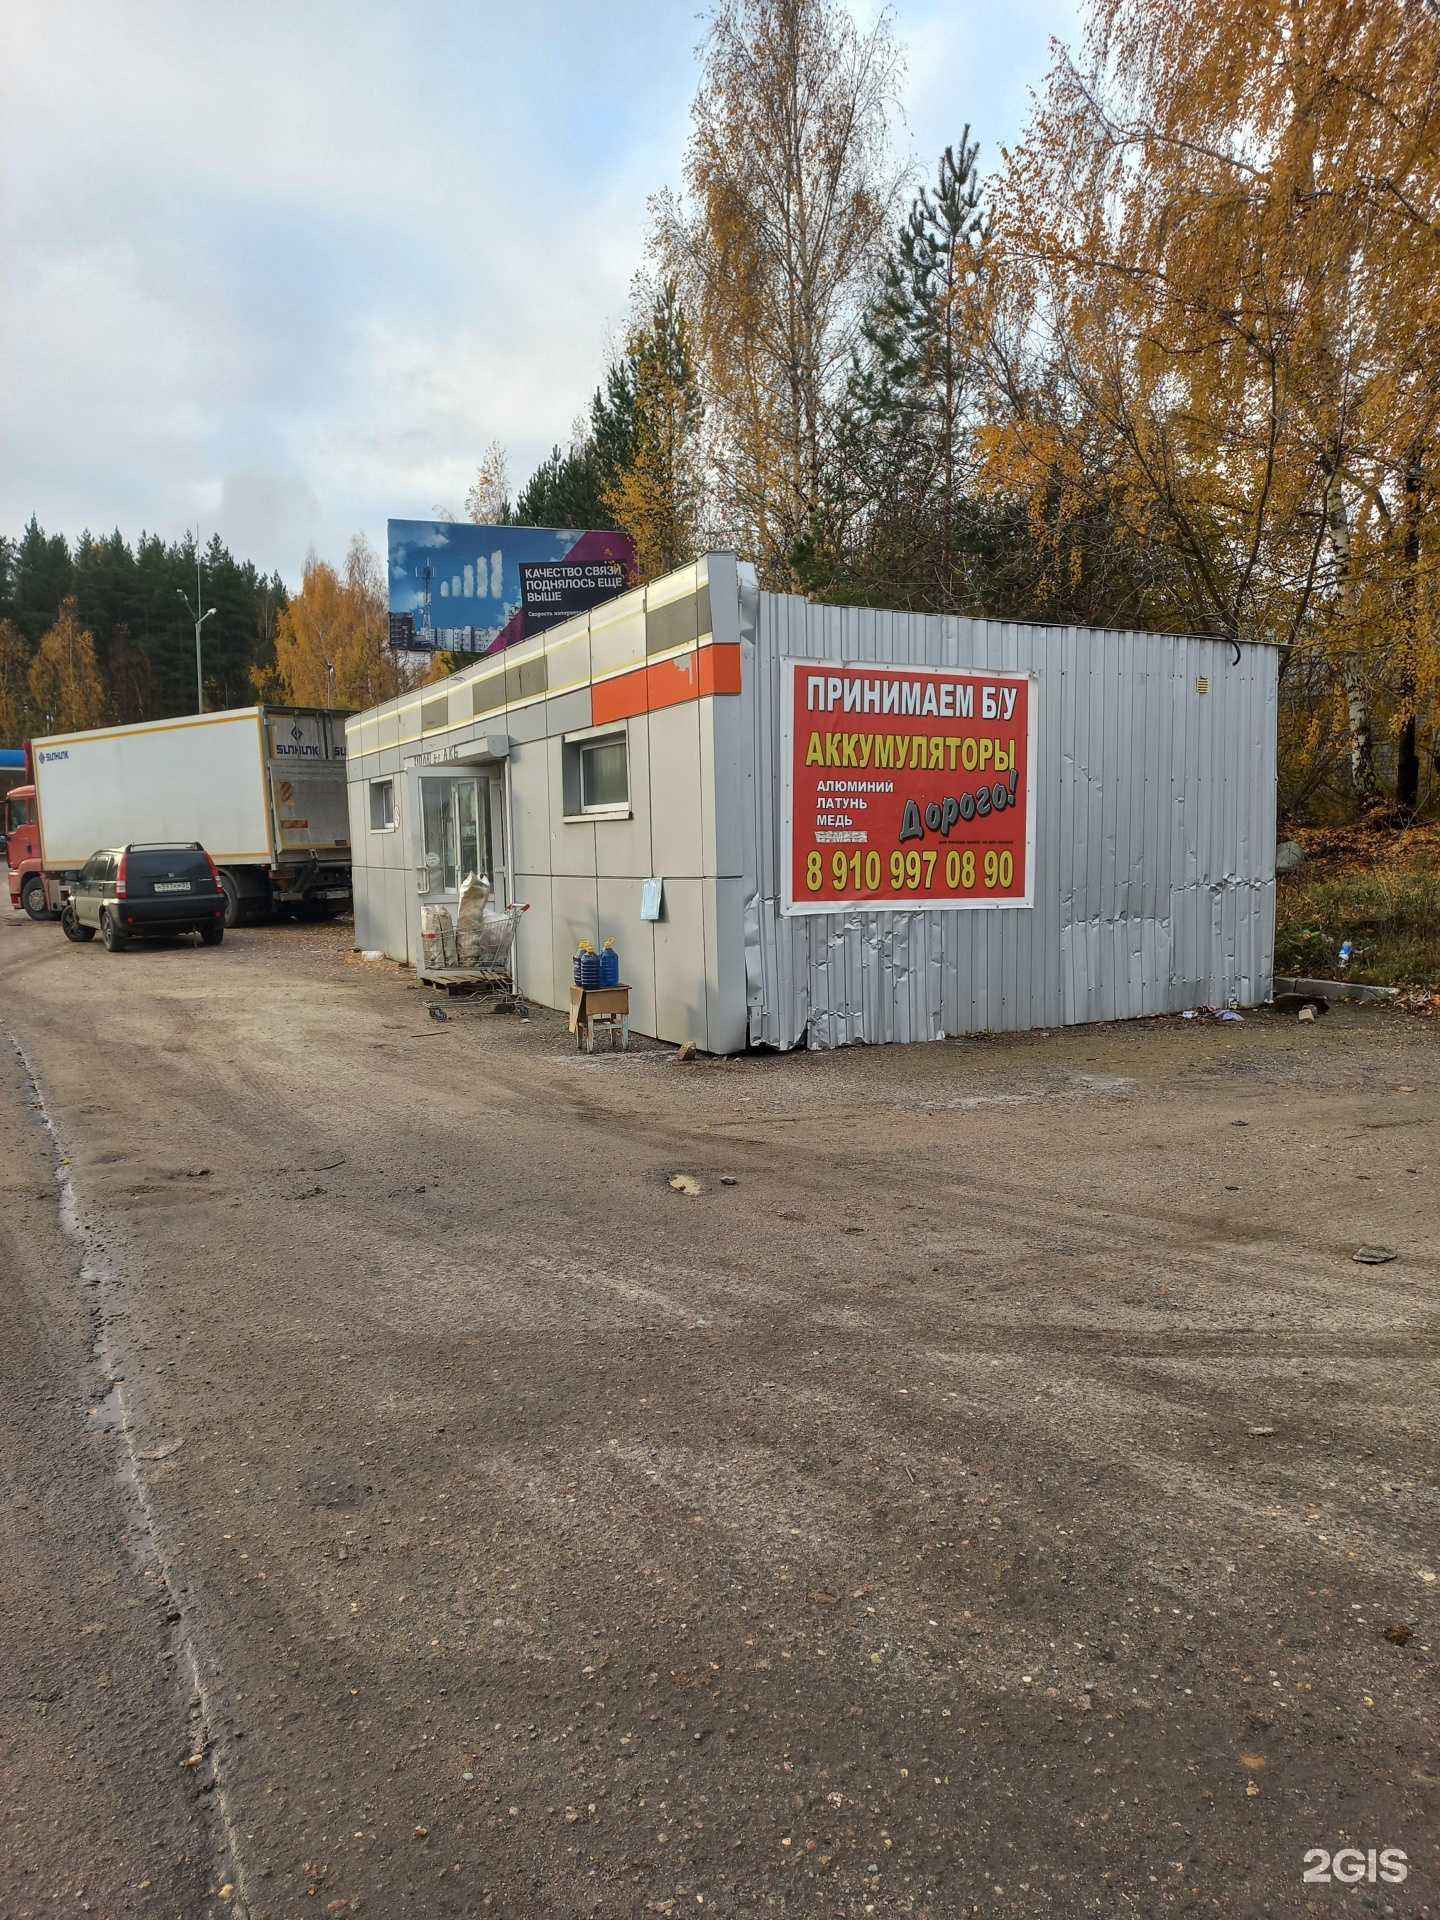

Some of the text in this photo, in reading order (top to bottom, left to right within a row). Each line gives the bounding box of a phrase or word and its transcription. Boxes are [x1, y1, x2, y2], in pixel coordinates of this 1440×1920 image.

[525, 564, 621, 579] КАЧЕСТВО СВЯЗИ
[526, 579, 595, 592] ПОДНЯЛОСЬ
[527, 591, 562, 602] ВЫШЕ
[528, 611, 553, 619] Скорость
[807, 675, 1018, 721] ПРИНИМАЕМ Б/У
[805, 731, 1016, 772] АККУМУЛЯТОРЫ
[816, 780, 894, 793] АЛЮМИНИЙ
[816, 797, 868, 809] ЛАТУНЬ
[899, 768, 1018, 842] Дорого!
[816, 814, 853, 827] МЕДЬ
[806, 850, 1014, 891] 8 910 997 08 90
